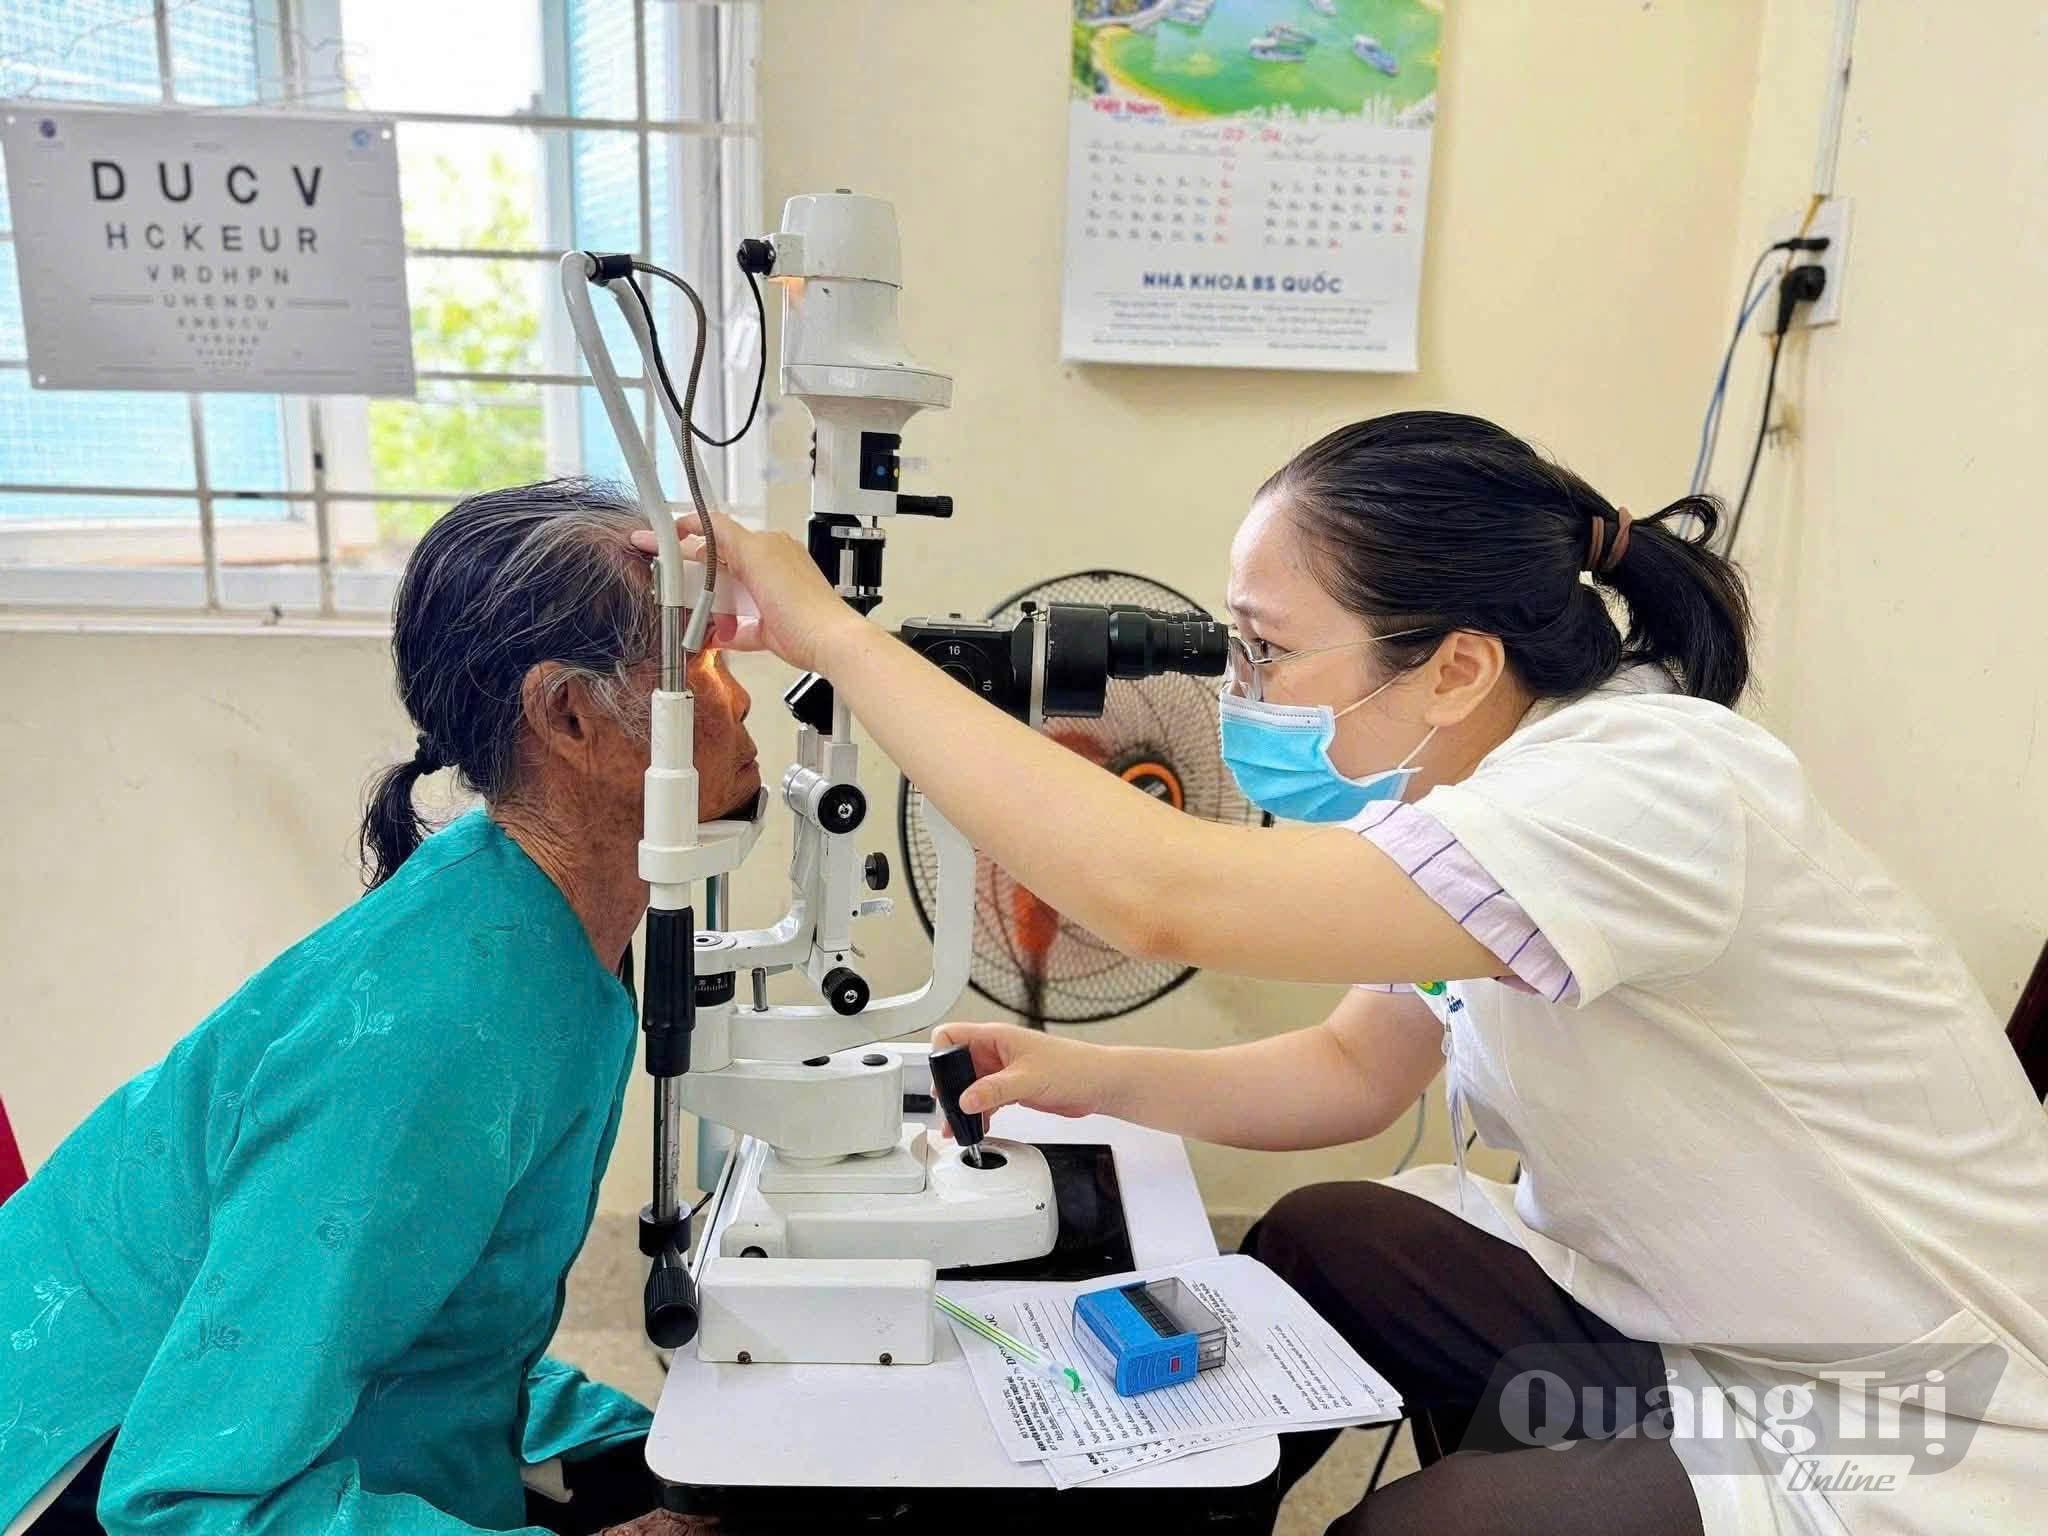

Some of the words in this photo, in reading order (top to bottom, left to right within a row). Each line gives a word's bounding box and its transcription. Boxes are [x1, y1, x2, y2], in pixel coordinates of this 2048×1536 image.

[1142, 271, 1185, 290] NHA
[1189, 272, 1247, 292] KHOA
[1281, 271, 1342, 294] QUỐC
[949, 645, 961, 656] 16
[982, 679, 992, 692] 10
